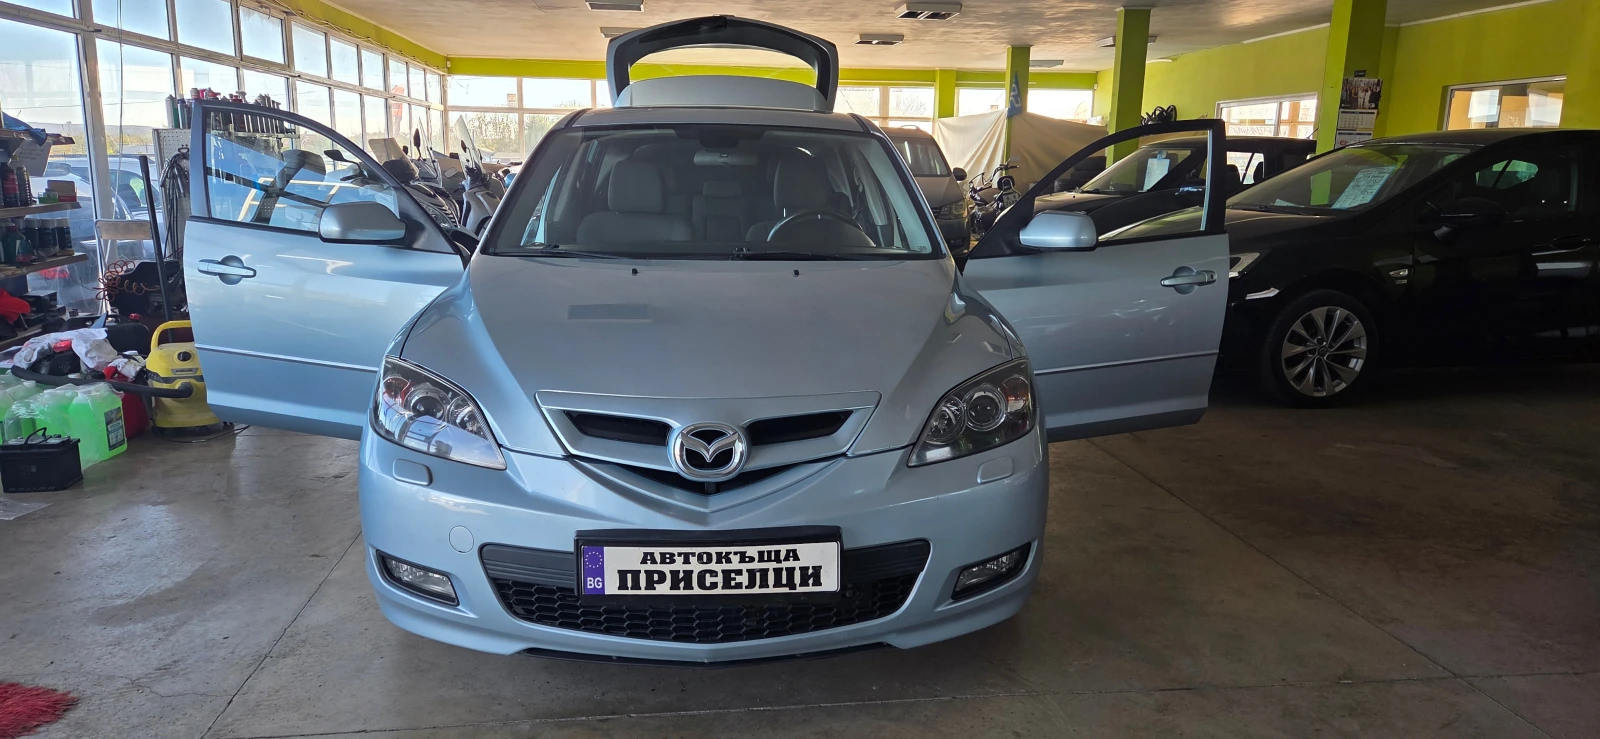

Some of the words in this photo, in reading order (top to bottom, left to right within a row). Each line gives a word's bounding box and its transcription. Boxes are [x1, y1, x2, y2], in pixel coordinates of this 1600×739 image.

[640, 549, 800, 565] АВТОКЪЩА
[587, 577, 602, 589] BG
[617, 565, 822, 591] ПРИСЕЛЦИ
